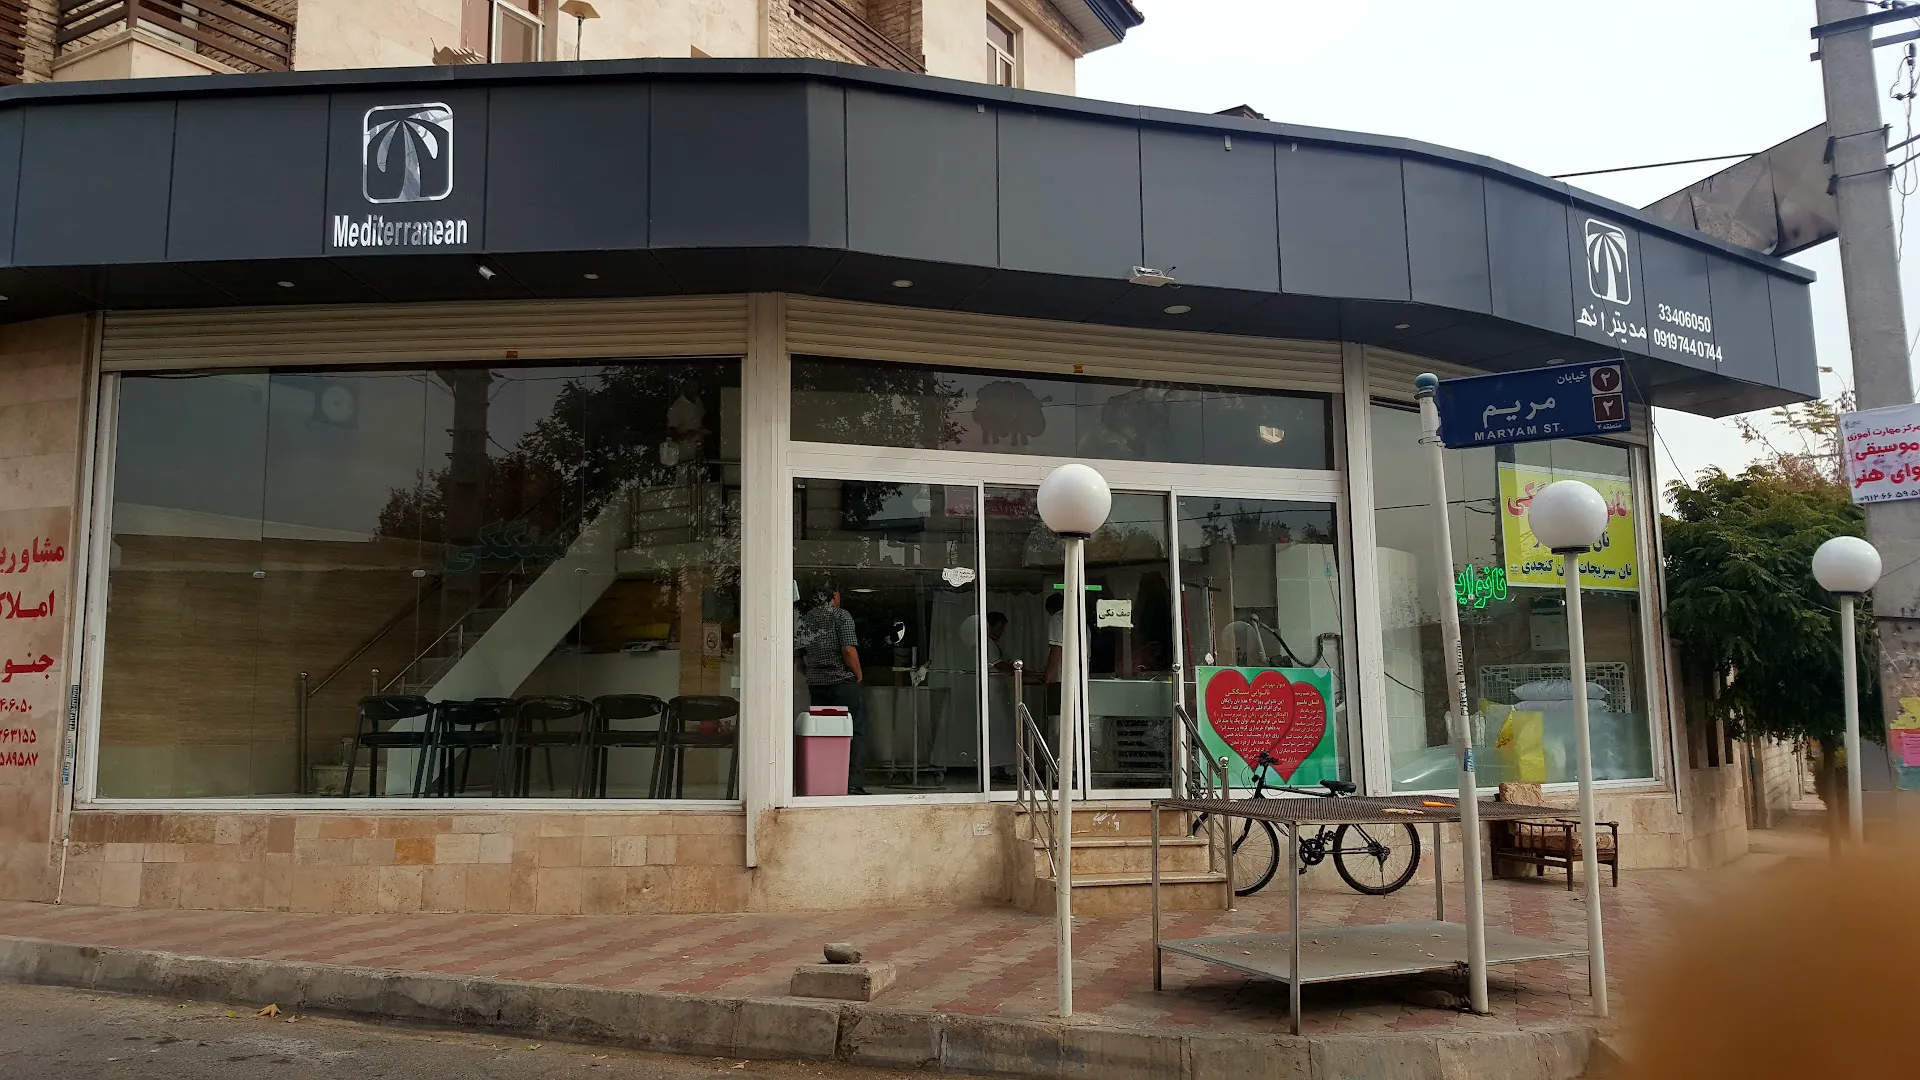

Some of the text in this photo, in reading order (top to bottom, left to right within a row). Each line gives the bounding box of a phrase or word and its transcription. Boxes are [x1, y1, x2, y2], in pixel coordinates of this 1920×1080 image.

[333, 214, 468, 248] Mediterranean
[1658, 303, 1711, 333] 33406050
[1654, 328, 1723, 363] 09197440744
[1557, 373, 1587, 385] خیابان
[1600, 372, 1610, 387] ۲
[1482, 396, 1556, 429] مریم
[1602, 400, 1613, 416] ۲
[1474, 422, 1564, 441] MARYAM ST.
[1847, 427, 1871, 441] آموزی
[1873, 427, 1901, 437] مهارت
[1855, 441, 1920, 461] موسیقی
[1854, 462, 1920, 489] وای هنر
[1521, 559, 1554, 576] کنجدی
[1618, 563, 1632, 580] نان
[1454, 563, 1507, 609] نانوای
[1, 652, 55, 683] جنو
[0, 698, 33, 713] ۴۰۶۰۵۰
[0, 751, 38, 767] ۵۸۹۵۸۷
